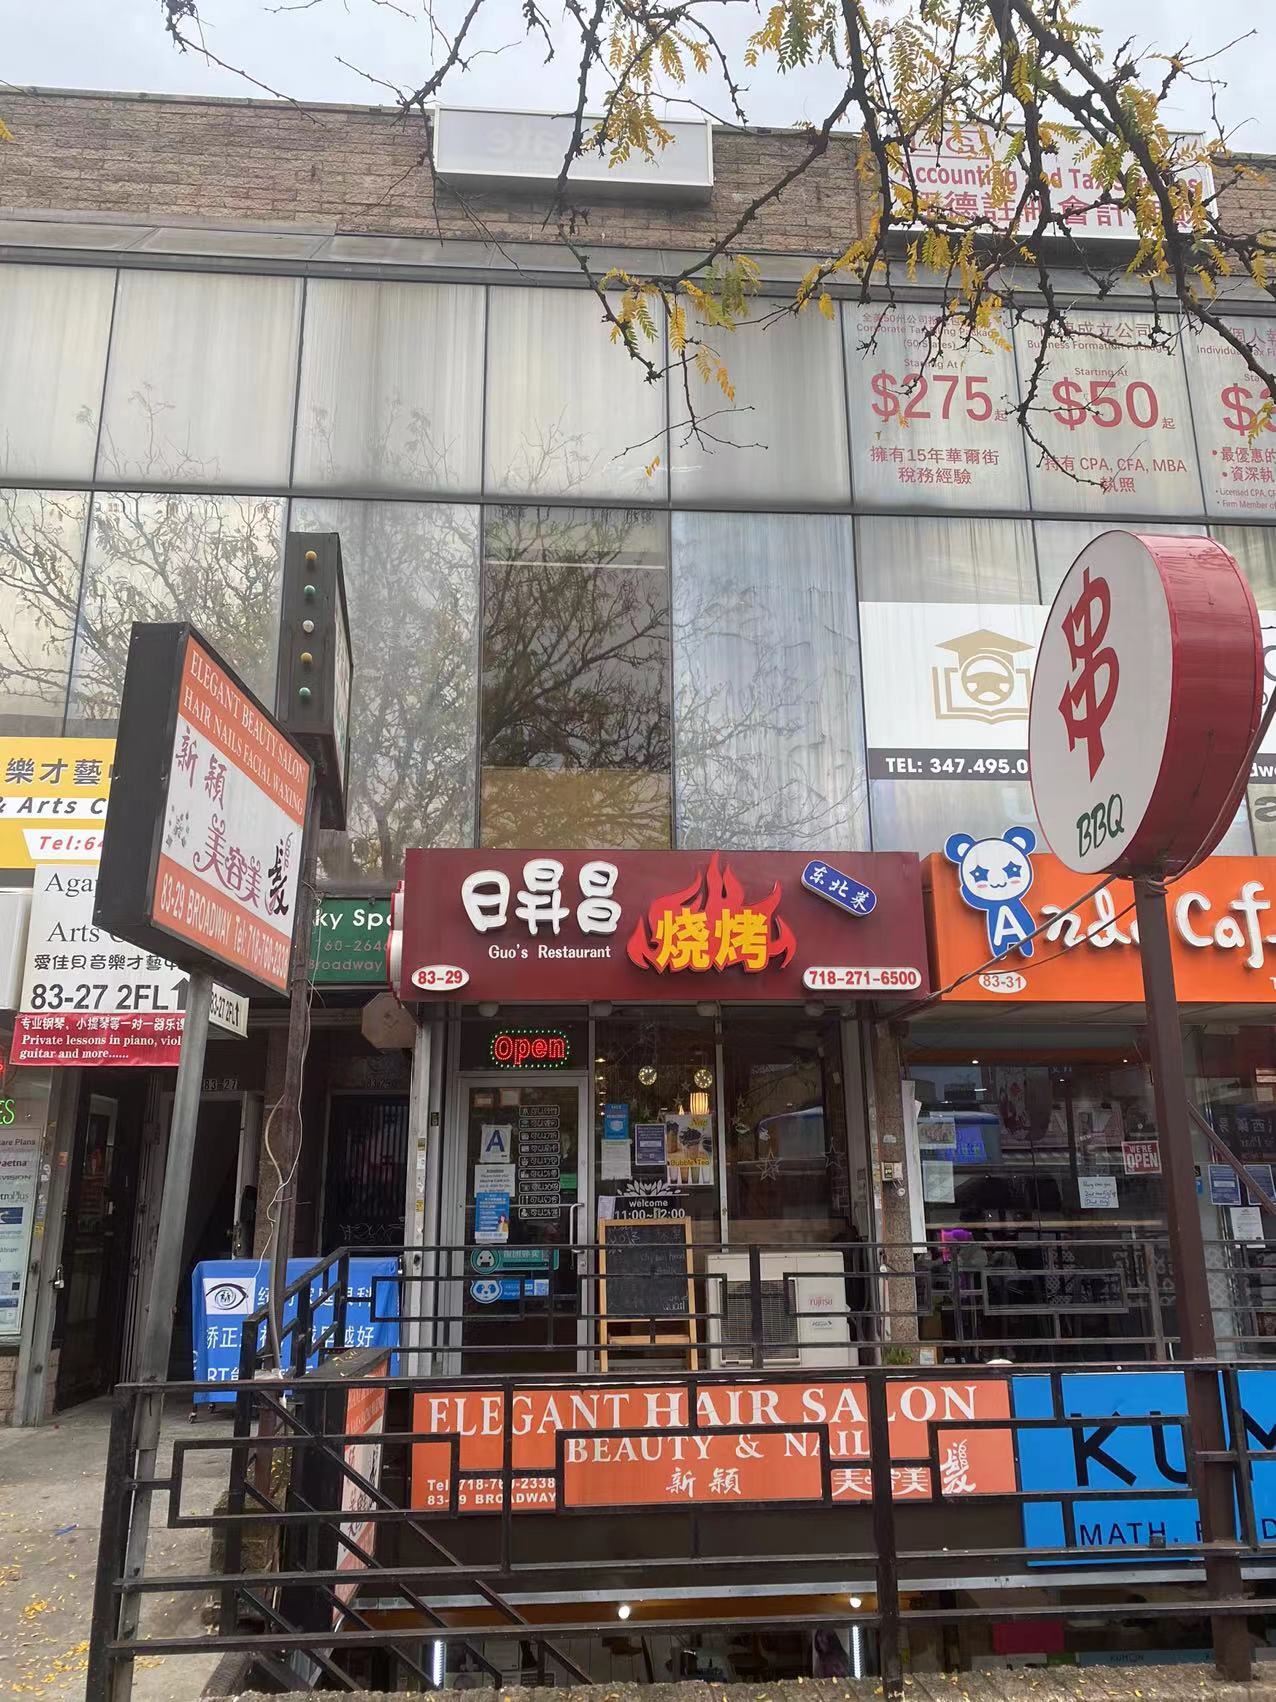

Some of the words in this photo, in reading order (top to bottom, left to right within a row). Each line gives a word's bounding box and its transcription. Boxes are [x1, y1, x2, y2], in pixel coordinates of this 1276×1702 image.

[1027, 339, 1071, 351] Buness
[1074, 367, 1114, 377] Starting
[1117, 369, 1129, 377] At
[870, 369, 993, 423] $275
[1052, 376, 1160, 431] $50
[870, 445, 1000, 466] 擁有15年華爾街
[898, 466, 972, 485] 稅務經驗
[1081, 457, 1114, 474] CPA,
[1116, 458, 1150, 475] CFA,
[1152, 458, 1188, 473] MBA
[1219, 487, 1250, 497] Licensed
[1222, 499, 1239, 508] Firm
[1239, 500, 1269, 509] Member
[191, 649, 240, 719] ELEGANT
[241, 703, 278, 758] BEAUTY
[277, 743, 306, 784] SALON
[183, 684, 212, 729] HAIR
[212, 714, 243, 758] NAILS
[243, 742, 271, 786] FACIAL
[272, 771, 304, 816] WAXING
[885, 757, 923, 774] TEL:
[17, 796, 78, 815] Arts
[1076, 793, 1126, 858] BBQ
[809, 866, 871, 913] 东北菜
[160, 873, 186, 921] 83-29
[186, 888, 233, 945] BROADWAY
[352, 908, 392, 931] Sp
[47, 921, 100, 943] Arts
[655, 907, 769, 970] 烧烤
[488, 943, 529, 959] Guo's
[538, 944, 612, 959] Restaurant
[417, 969, 464, 986] 83-29
[809, 970, 918, 986] 718-271-6500
[982, 974, 1023, 989] 83-31
[30, 983, 109, 1010] 83-27
[115, 984, 169, 1010] 2FL
[21, 1034, 64, 1046] Private
[66, 1033, 107, 1045] lessons
[109, 1033, 121, 1045] in
[123, 1034, 157, 1048] piano,
[494, 1035, 566, 1065] Open
[19, 1047, 57, 1060] guitar
[58, 1048, 79, 1060] and
[15, 1137, 36, 1146] Plans
[485, 1129, 506, 1153] A
[1126, 1153, 1159, 1169] OPEN
[628, 1198, 669, 1208] welcome
[428, 1393, 629, 1437] ELEGANT
[643, 1390, 787, 1428] HAIR
[566, 1434, 715, 1464] BEAUTY
[735, 1433, 765, 1459] &
[427, 1494, 467, 1506] 83-9
